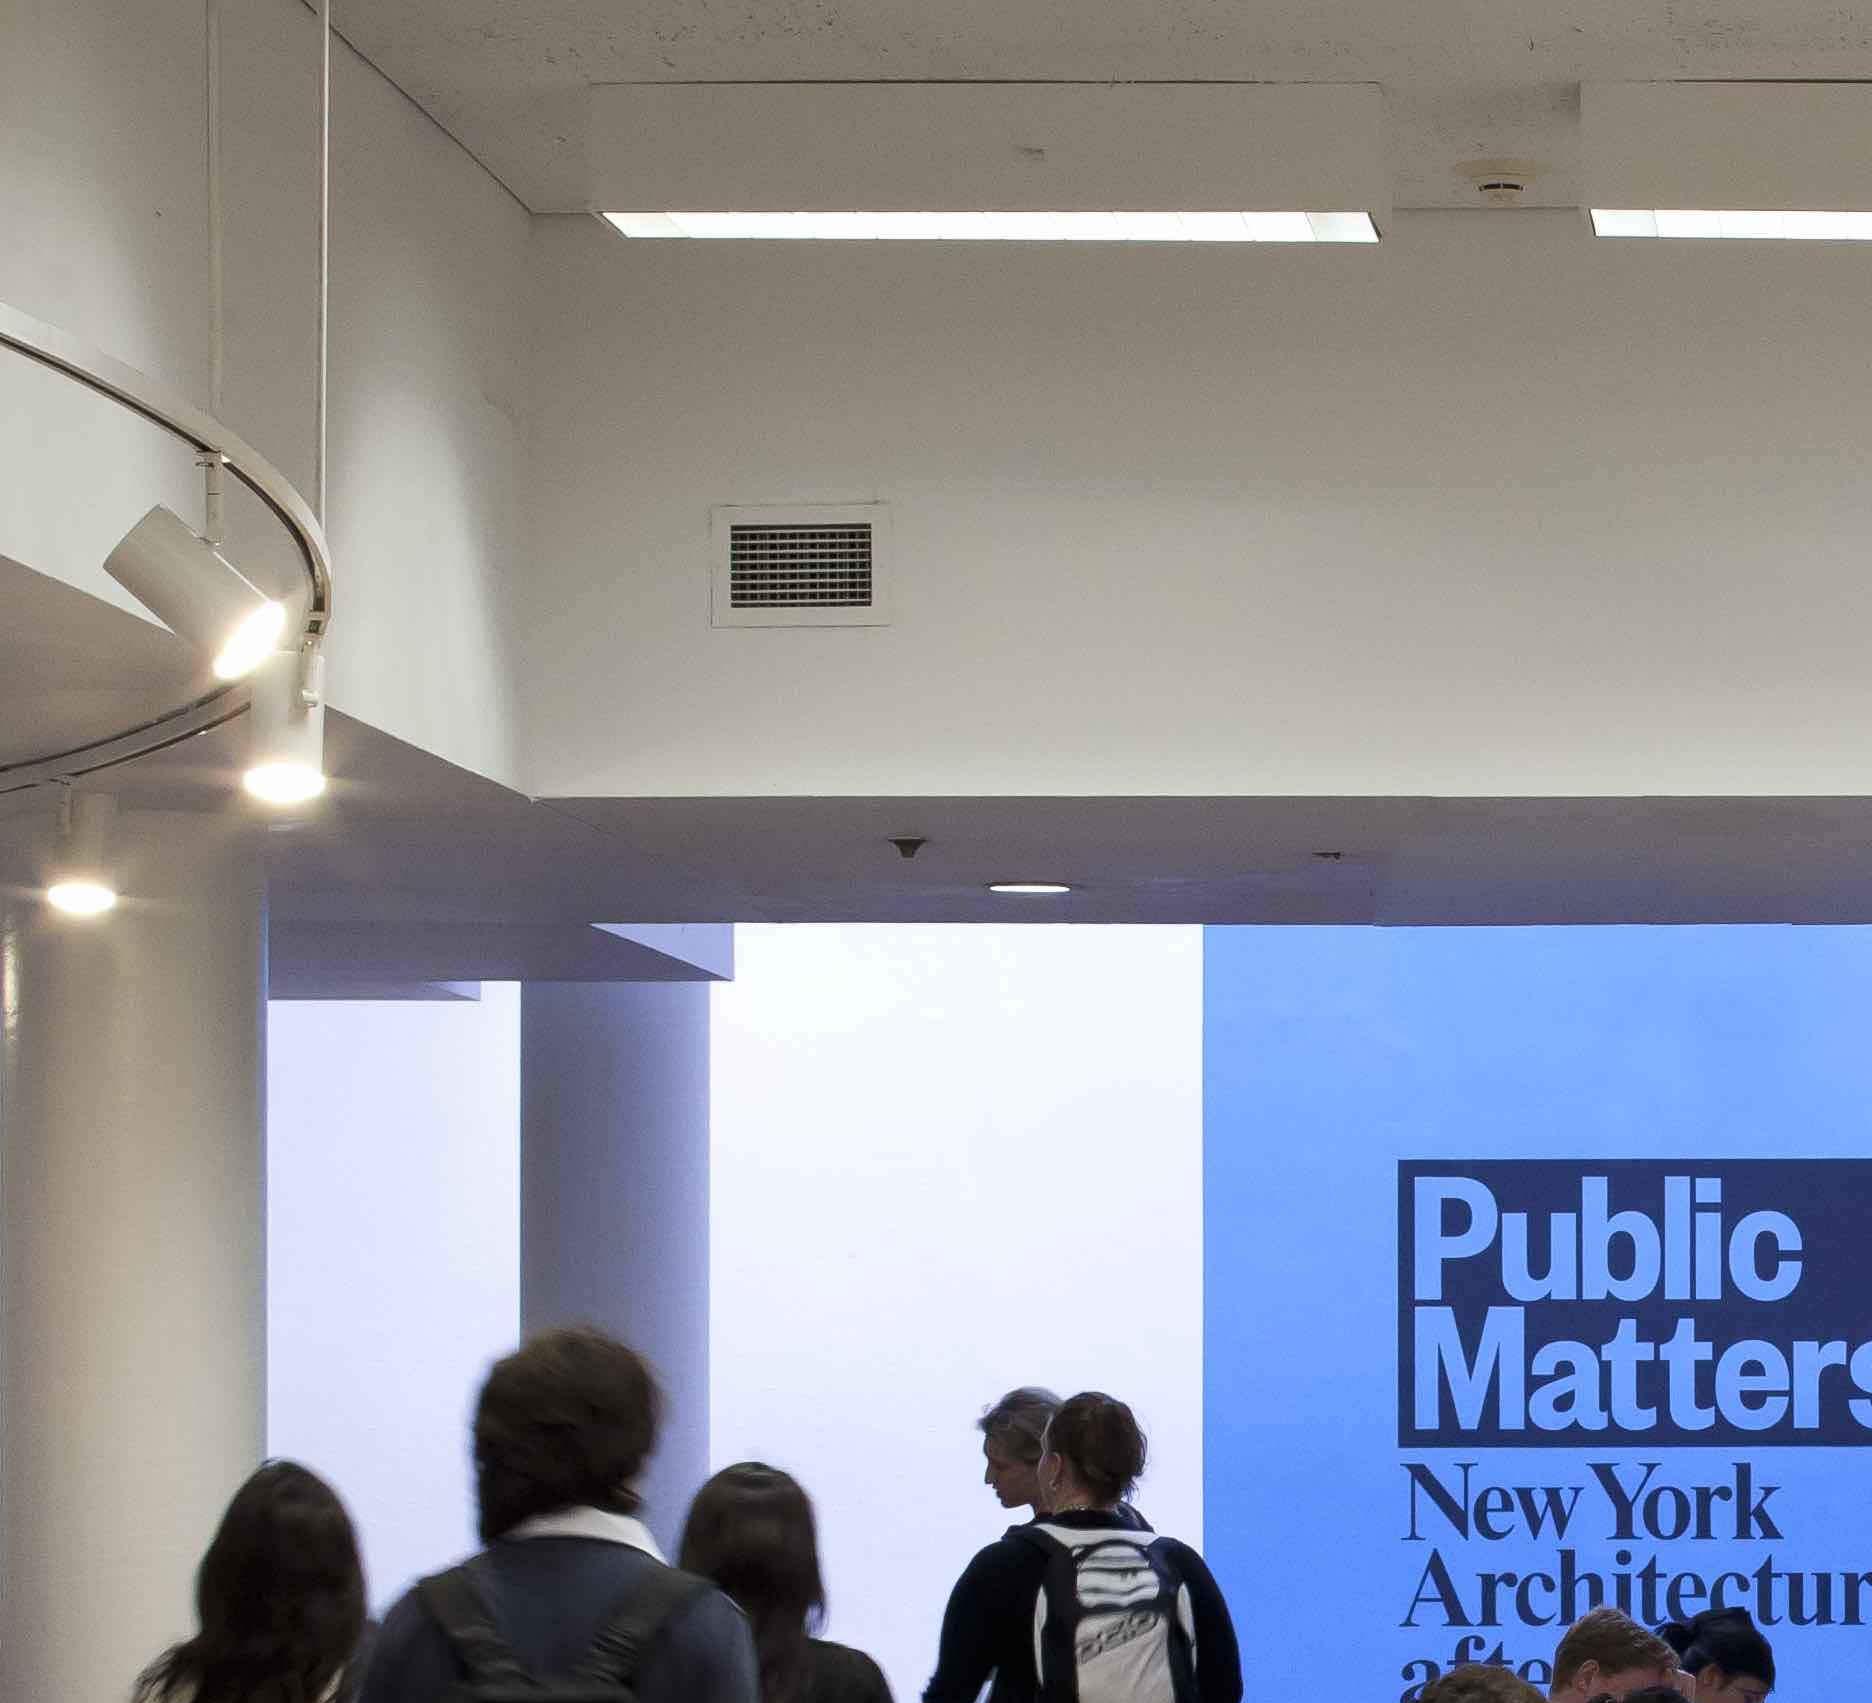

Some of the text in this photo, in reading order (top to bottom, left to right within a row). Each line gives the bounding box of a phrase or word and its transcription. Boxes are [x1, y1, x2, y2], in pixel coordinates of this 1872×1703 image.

[1413, 1176, 1802, 1301] Public
[1400, 1462, 1783, 1541] New York
